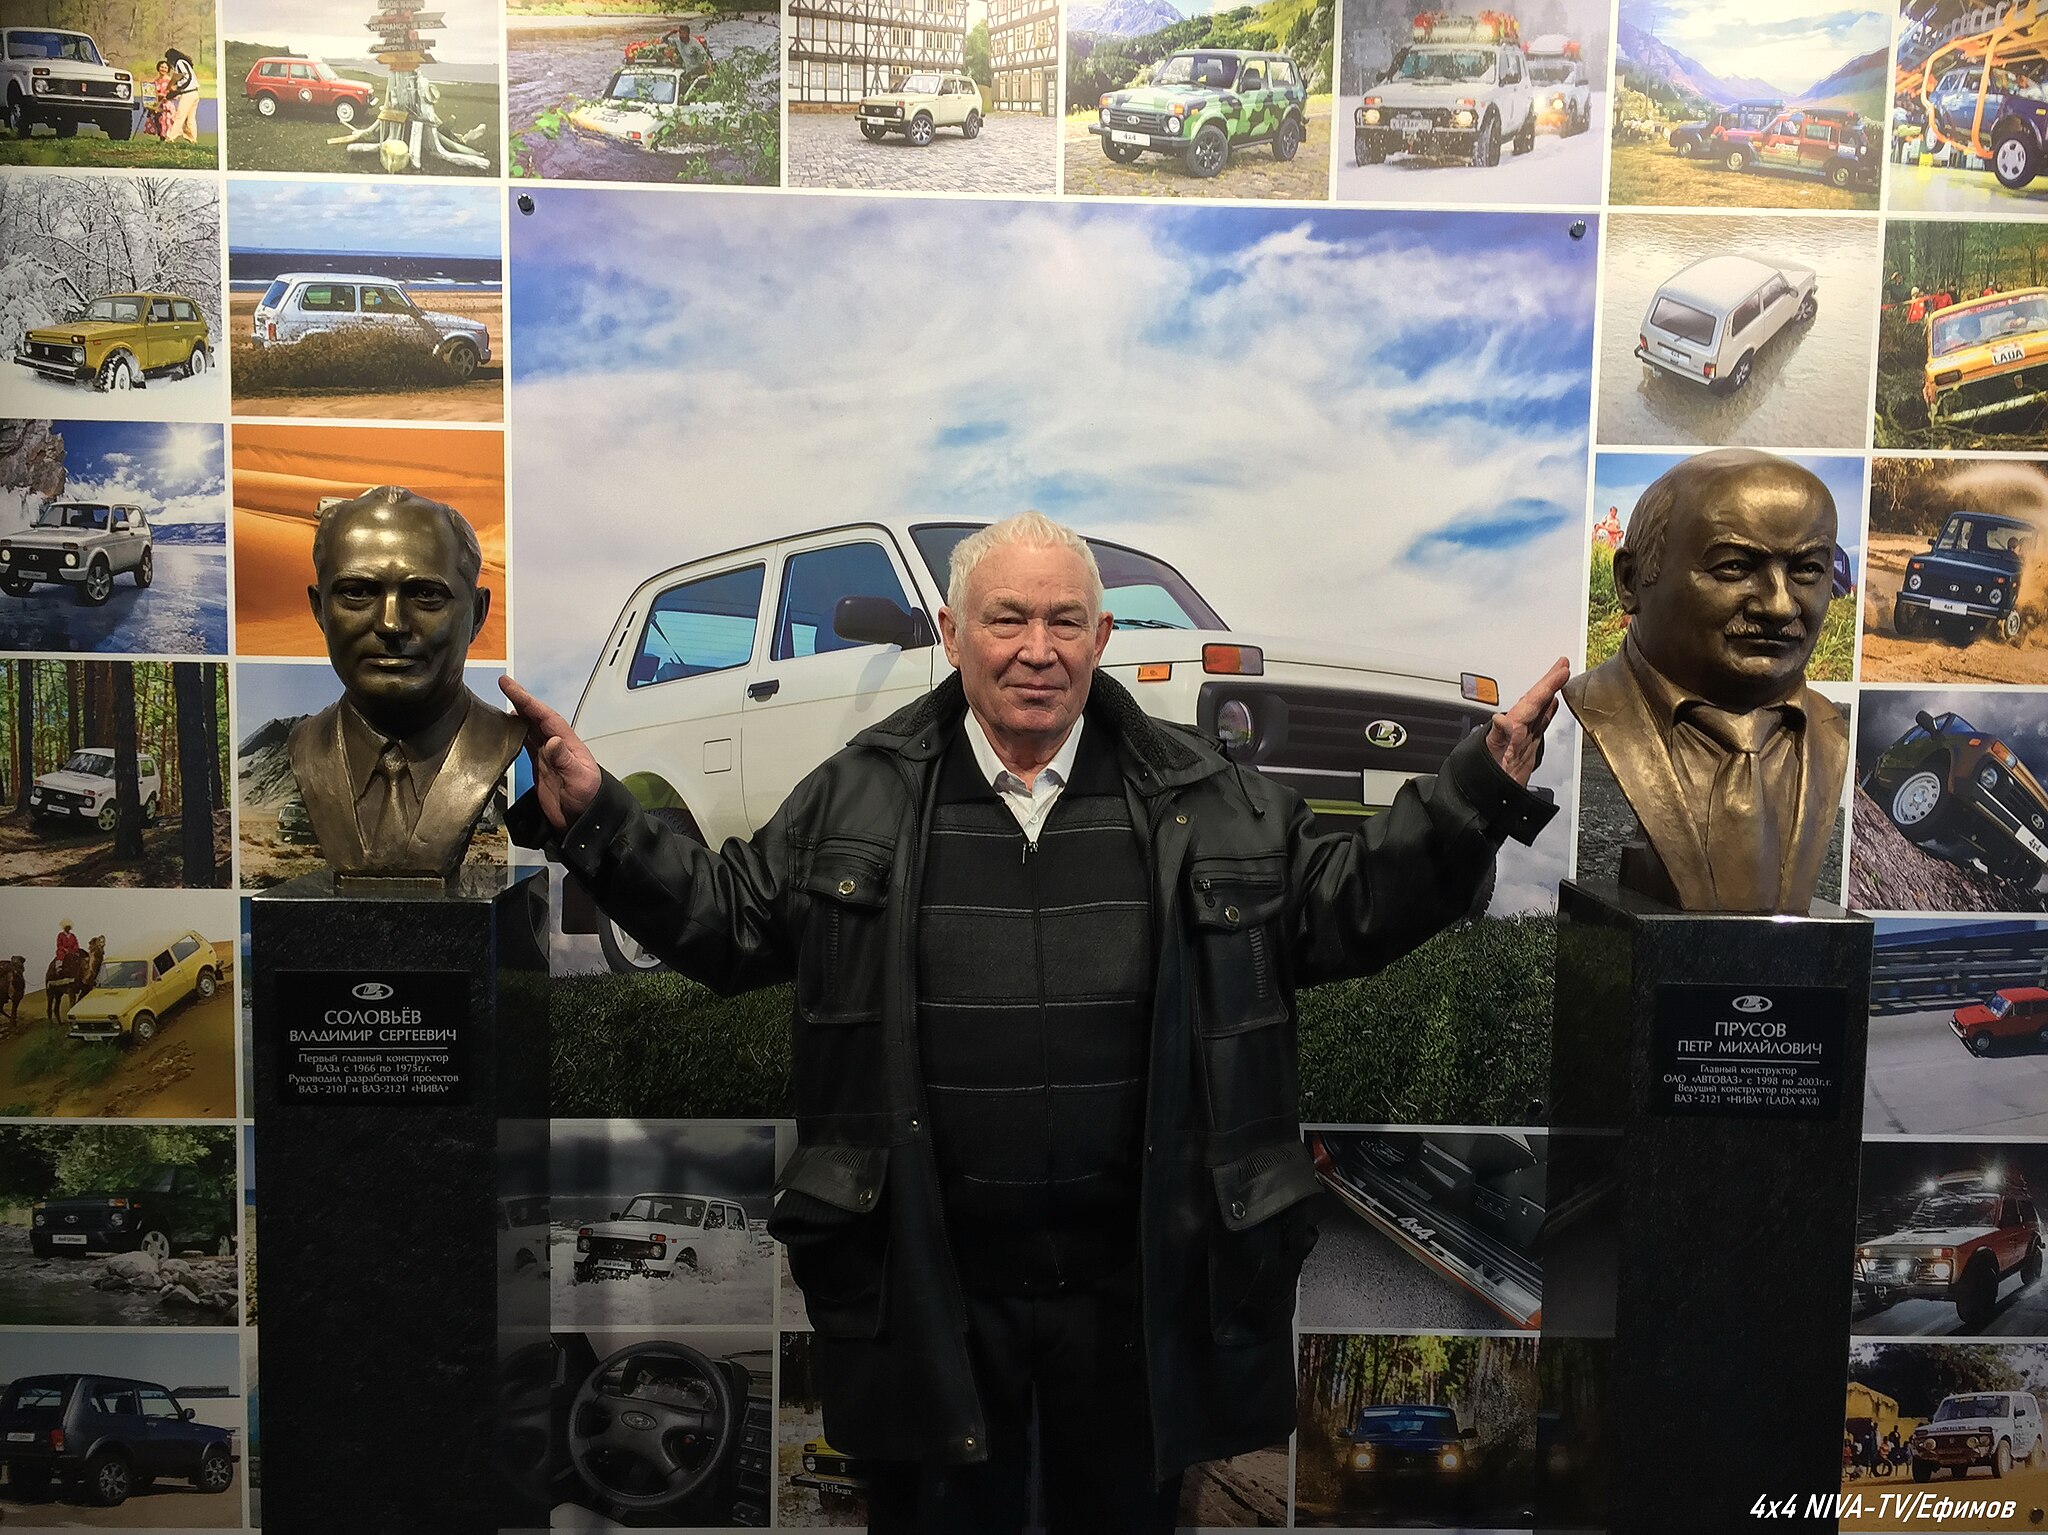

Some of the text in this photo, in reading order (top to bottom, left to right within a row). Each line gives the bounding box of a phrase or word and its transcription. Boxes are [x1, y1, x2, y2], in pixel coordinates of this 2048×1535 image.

[324, 1006, 422, 1025] СОЛОВЬЁВ
[289, 1029, 457, 1042] ВЛАДИМИР СЕРГЕЕВИЧ
[1714, 1021, 1787, 1038] ПРУСОВ
[1677, 1039, 1823, 1055] ПЕТР МИХАЙЛОВИЧ
[298, 1054, 449, 1064] Первый главный конструктор
[316, 1065, 340, 1073] ВАЗа
[353, 1064, 376, 1072] 1966
[1700, 1064, 1798, 1077] Главный конструктор
[288, 1073, 459, 1085] Руководил разработкой проектов
[1663, 1074, 1687, 1084] ОАО
[1692, 1075, 1743, 1085] «АВТОВАЗ»
[1756, 1076, 1778, 1085] 1998
[1782, 1078, 1794, 1086] по
[411, 1085, 449, 1093] «НИВА»
[1721, 1084, 1777, 1095] конструктор
[1781, 1087, 1817, 1096] проекта
[1726, 1095, 1763, 1104] «НИВА»
[1766, 1096, 1796, 1106] (LADA
[1397, 1217, 1436, 1241] 4x4
